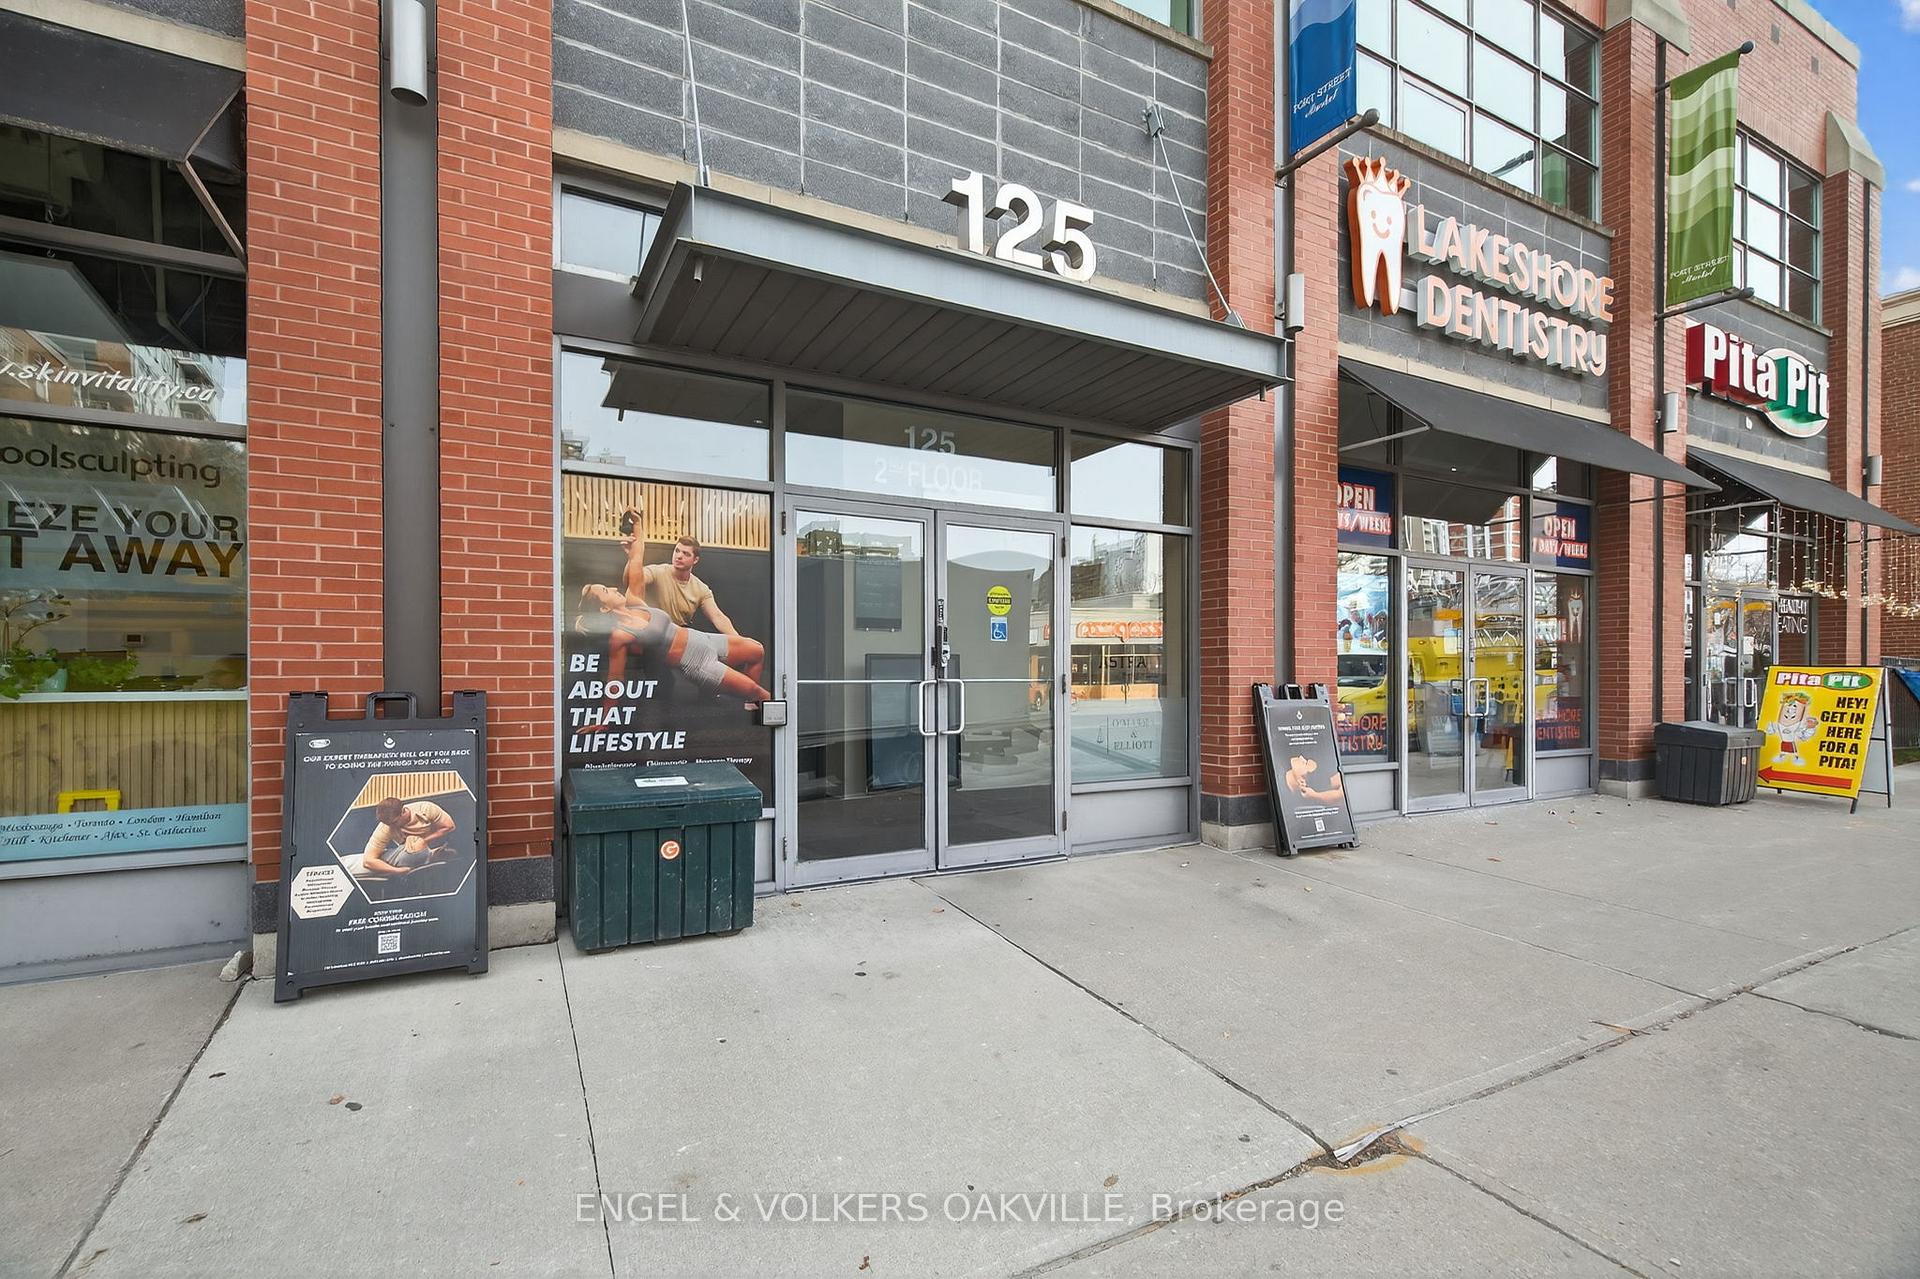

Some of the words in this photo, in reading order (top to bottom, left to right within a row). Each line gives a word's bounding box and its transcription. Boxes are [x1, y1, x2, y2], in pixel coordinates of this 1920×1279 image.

[942, 170, 1097, 284] 125
[1408, 204, 1614, 323] LAKESHORE
[1417, 275, 1607, 377] DENTISTRY
[1704, 322, 1778, 402] Pita
[1787, 356, 1830, 419] Pit
[903, 425, 957, 454] 125
[908, 461, 984, 491] FLOOR
[112, 506, 239, 541] YOUR
[59, 532, 244, 578] AWAY
[569, 653, 600, 672] BE
[568, 680, 658, 699] ABOUT
[1776, 672, 1821, 686] Pita
[1827, 673, 1861, 687] Pit
[1836, 696, 1869, 709] HEY!
[569, 706, 636, 726] THAT
[1820, 711, 1848, 723] GET
[1849, 712, 1865, 724] IN
[569, 731, 686, 753] LIFESTYLE
[1826, 726, 1863, 739] HERE
[1819, 740, 1846, 753] FOR
[1848, 743, 1859, 755] A
[1818, 755, 1857, 770] PITA!
[74, 819, 116, 828] Toronto
[127, 815, 166, 825] London
[175, 811, 221, 822] Hamilton
